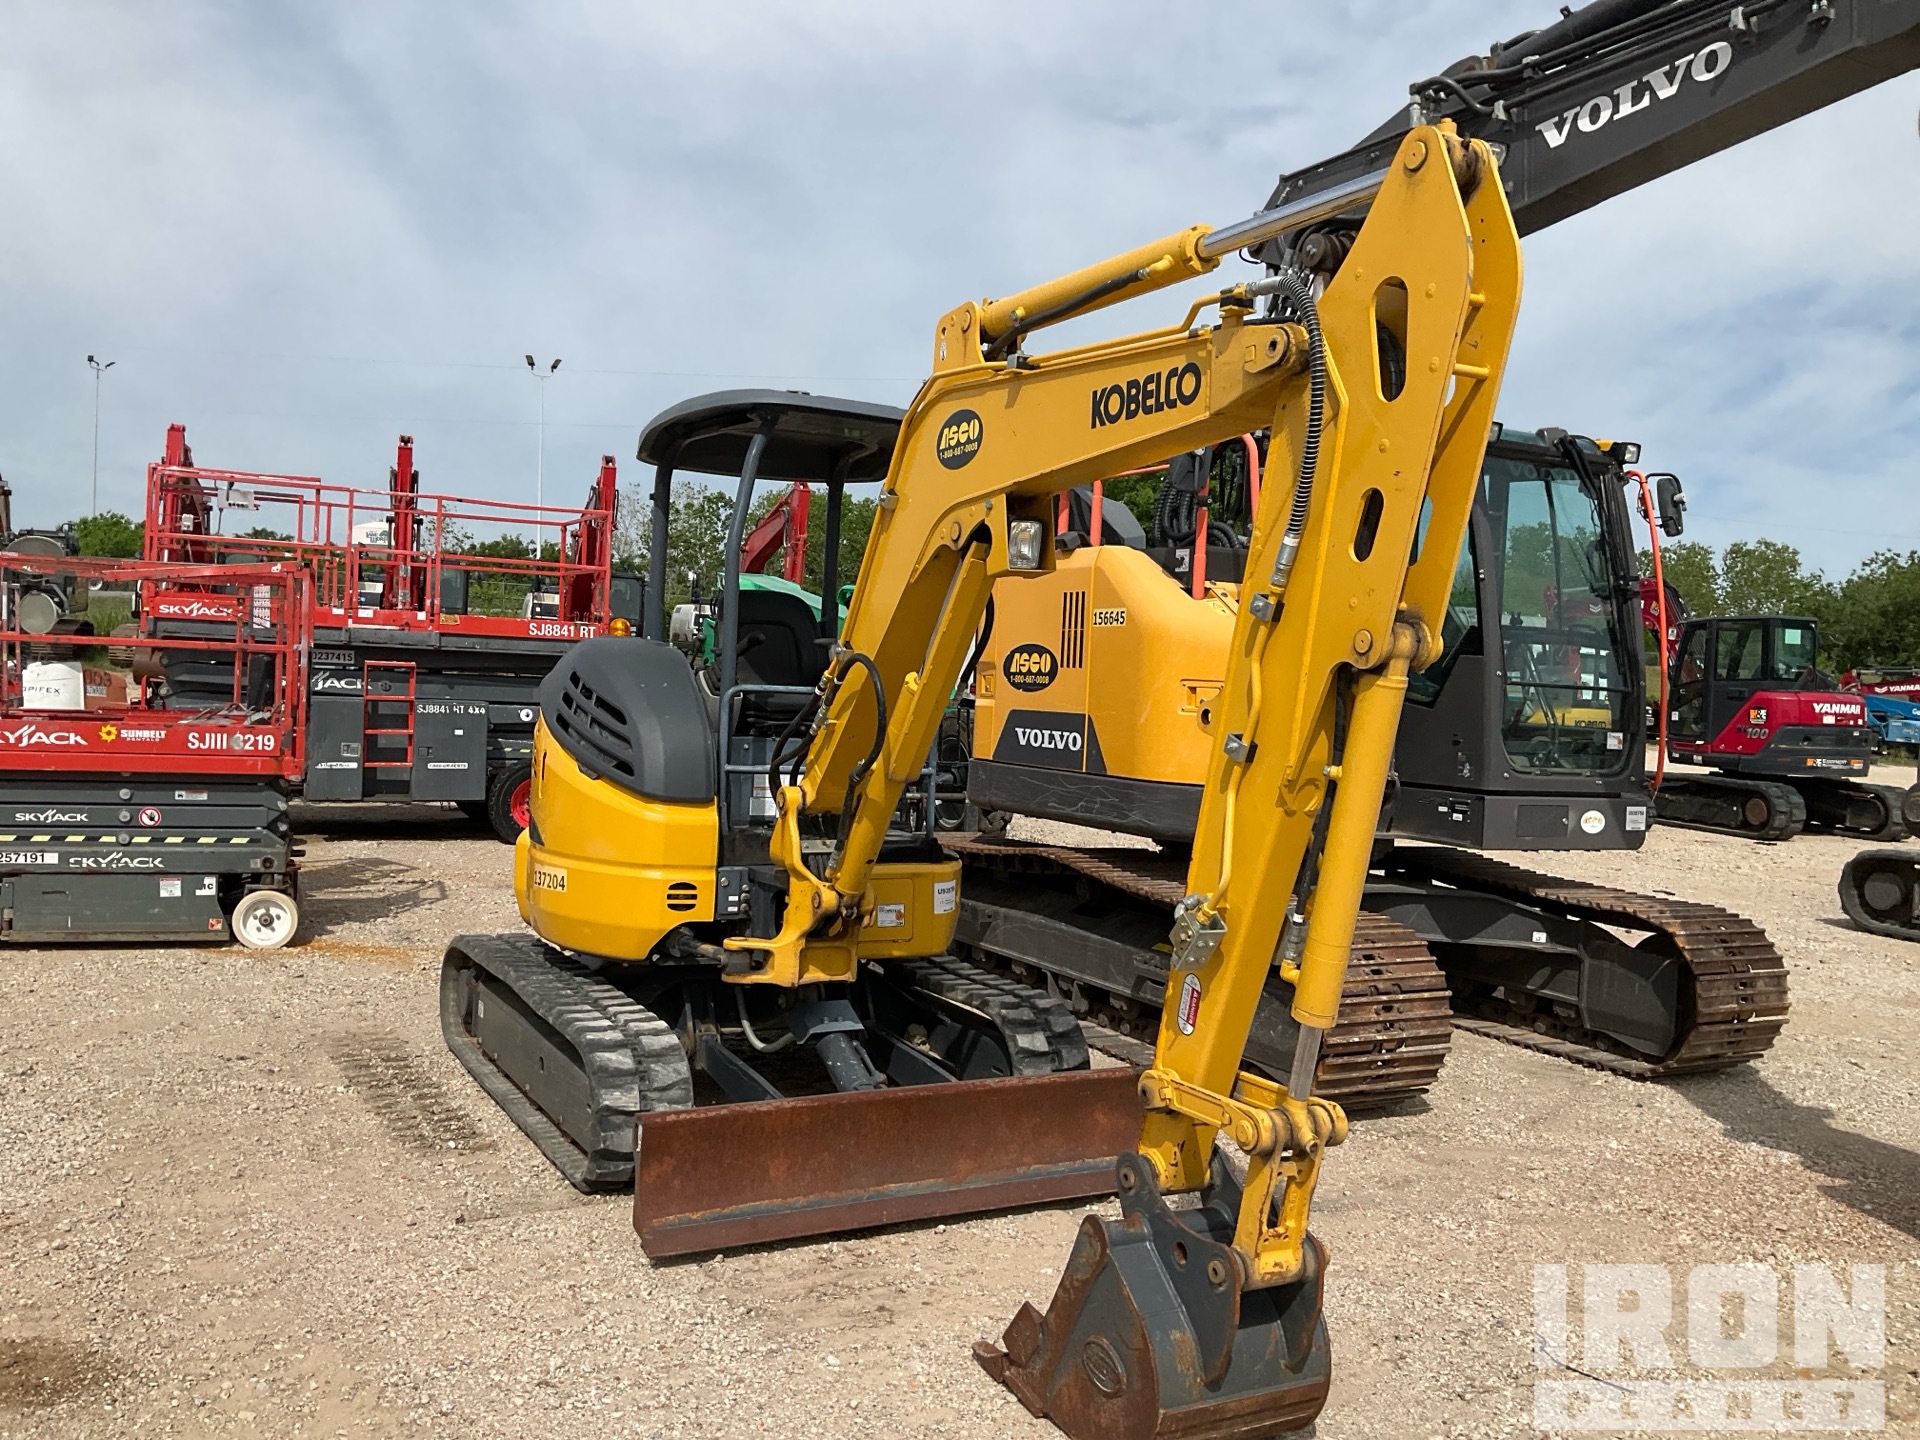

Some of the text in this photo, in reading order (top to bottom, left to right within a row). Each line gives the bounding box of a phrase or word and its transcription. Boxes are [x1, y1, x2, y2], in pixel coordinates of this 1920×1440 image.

[1535, 41, 1732, 148] VOLVO
[1091, 362, 1202, 429] KOBELCO
[939, 419, 980, 450] ASCO
[159, 602, 233, 616] SKYJACK
[1093, 611, 1126, 625] 156645
[529, 622, 596, 639] SJ8841 RT
[1010, 652, 1051, 673] ASCO
[416, 704, 450, 714] SJ8841
[1813, 703, 1860, 714] YANMAR
[120, 729, 167, 739] SUNBELT
[1015, 727, 1082, 751] VOLVO
[15, 809, 89, 823] SKYJACK
